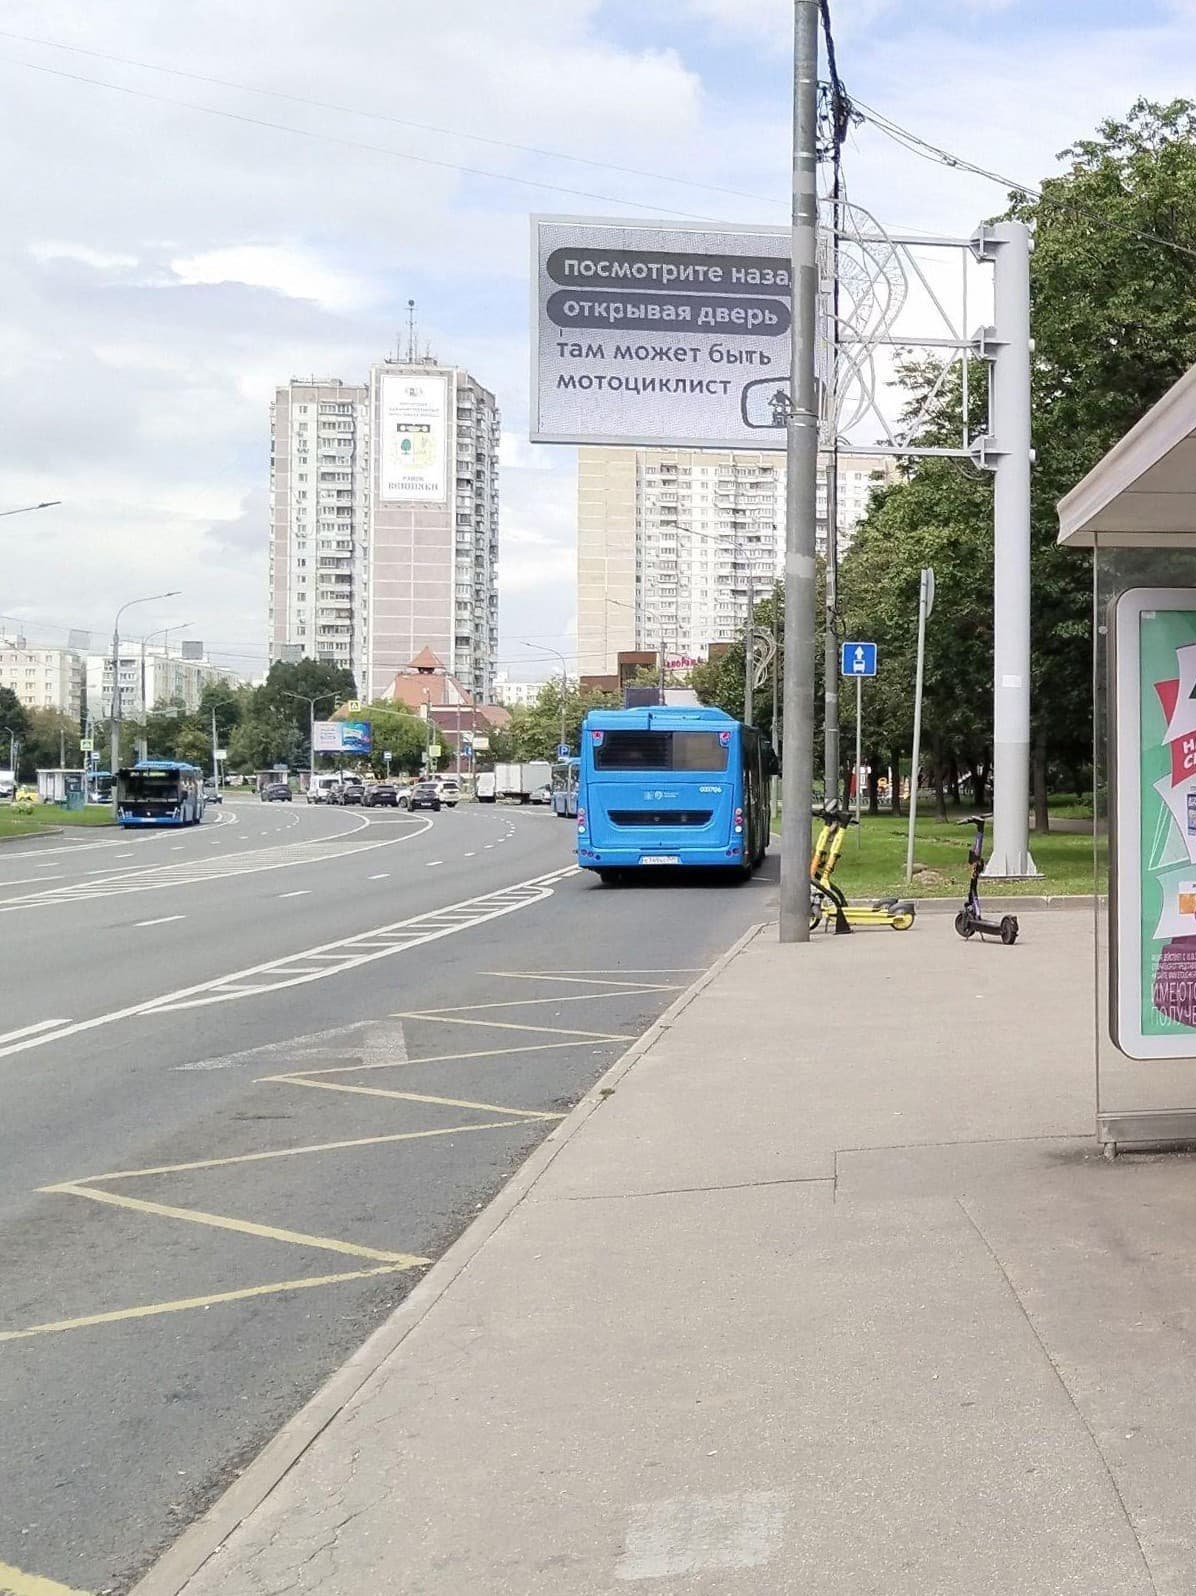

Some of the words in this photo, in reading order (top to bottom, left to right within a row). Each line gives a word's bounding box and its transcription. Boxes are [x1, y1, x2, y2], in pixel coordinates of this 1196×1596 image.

[564, 258, 723, 284] посмотрите
[732, 268, 792, 287] наза
[563, 300, 691, 323] открывая
[697, 307, 778, 329] дверь
[557, 341, 605, 360] там
[613, 344, 701, 363] может
[708, 343, 772, 365] быть
[557, 373, 731, 395] мотоциклист
